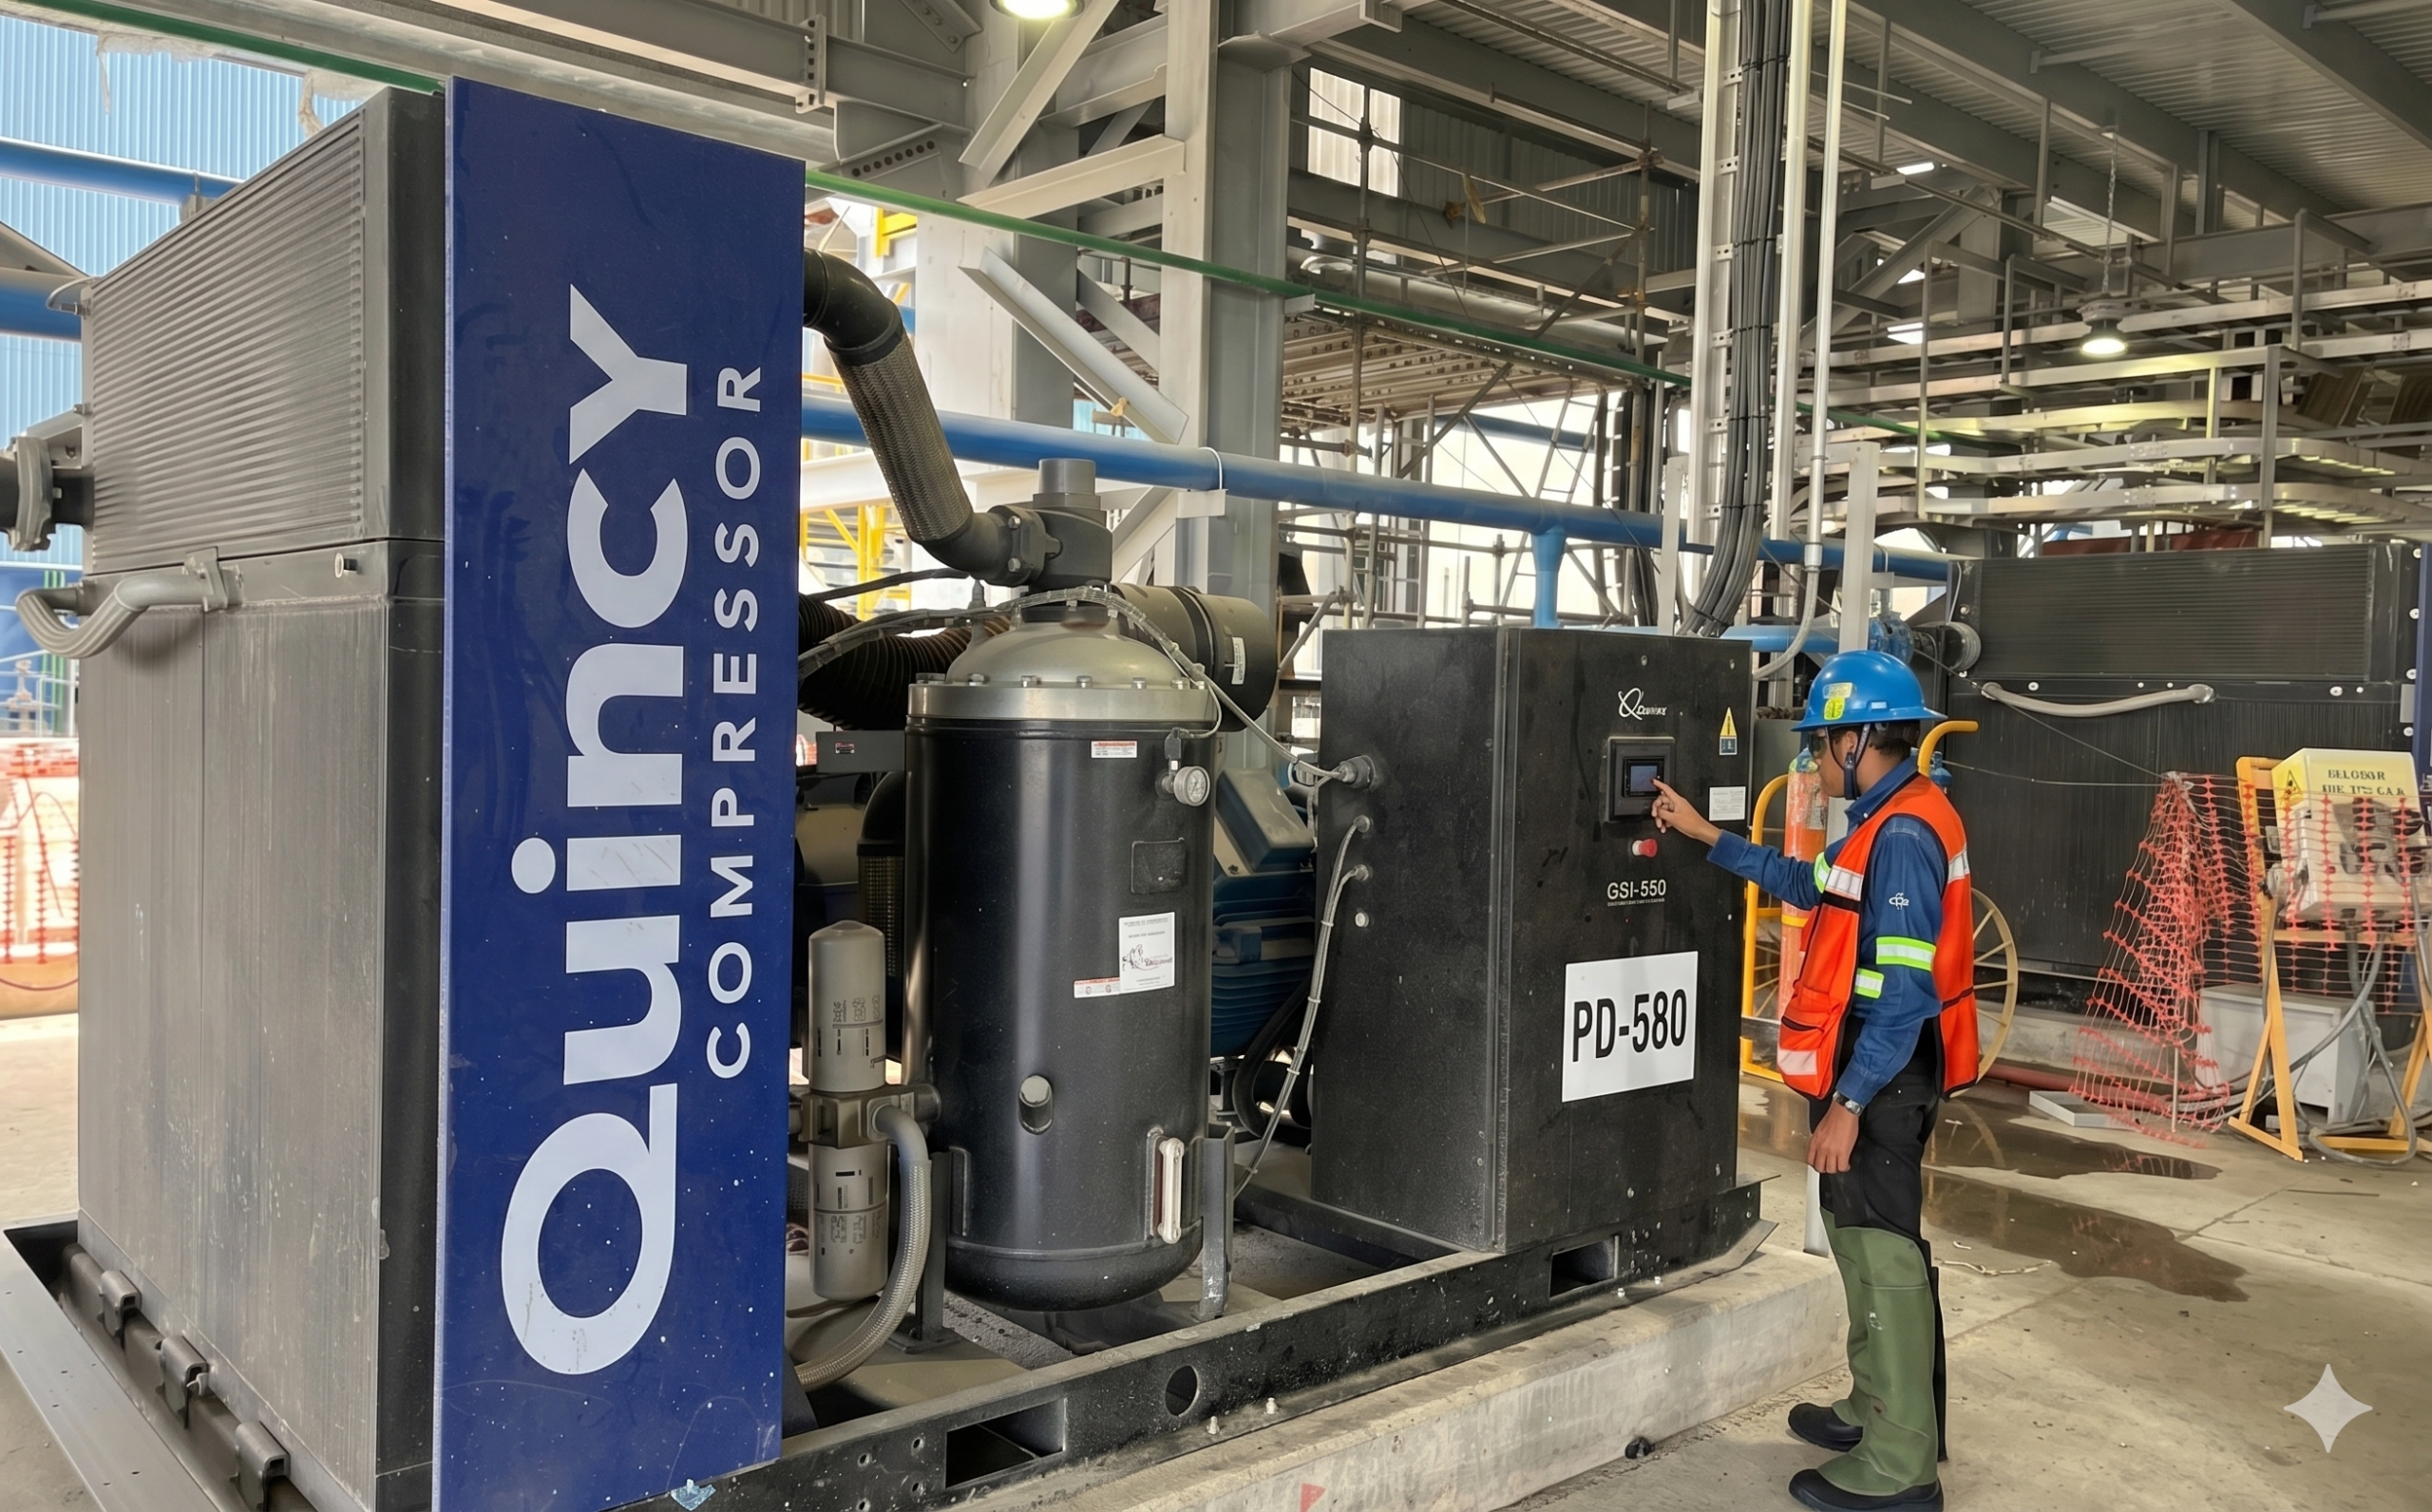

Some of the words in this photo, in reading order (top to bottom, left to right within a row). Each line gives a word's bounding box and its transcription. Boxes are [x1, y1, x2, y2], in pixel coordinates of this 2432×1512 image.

[707, 366, 762, 1079] COMPRESSOR
[1606, 879, 1666, 899] GSI-550
[1572, 989, 1687, 1063] PD-580
